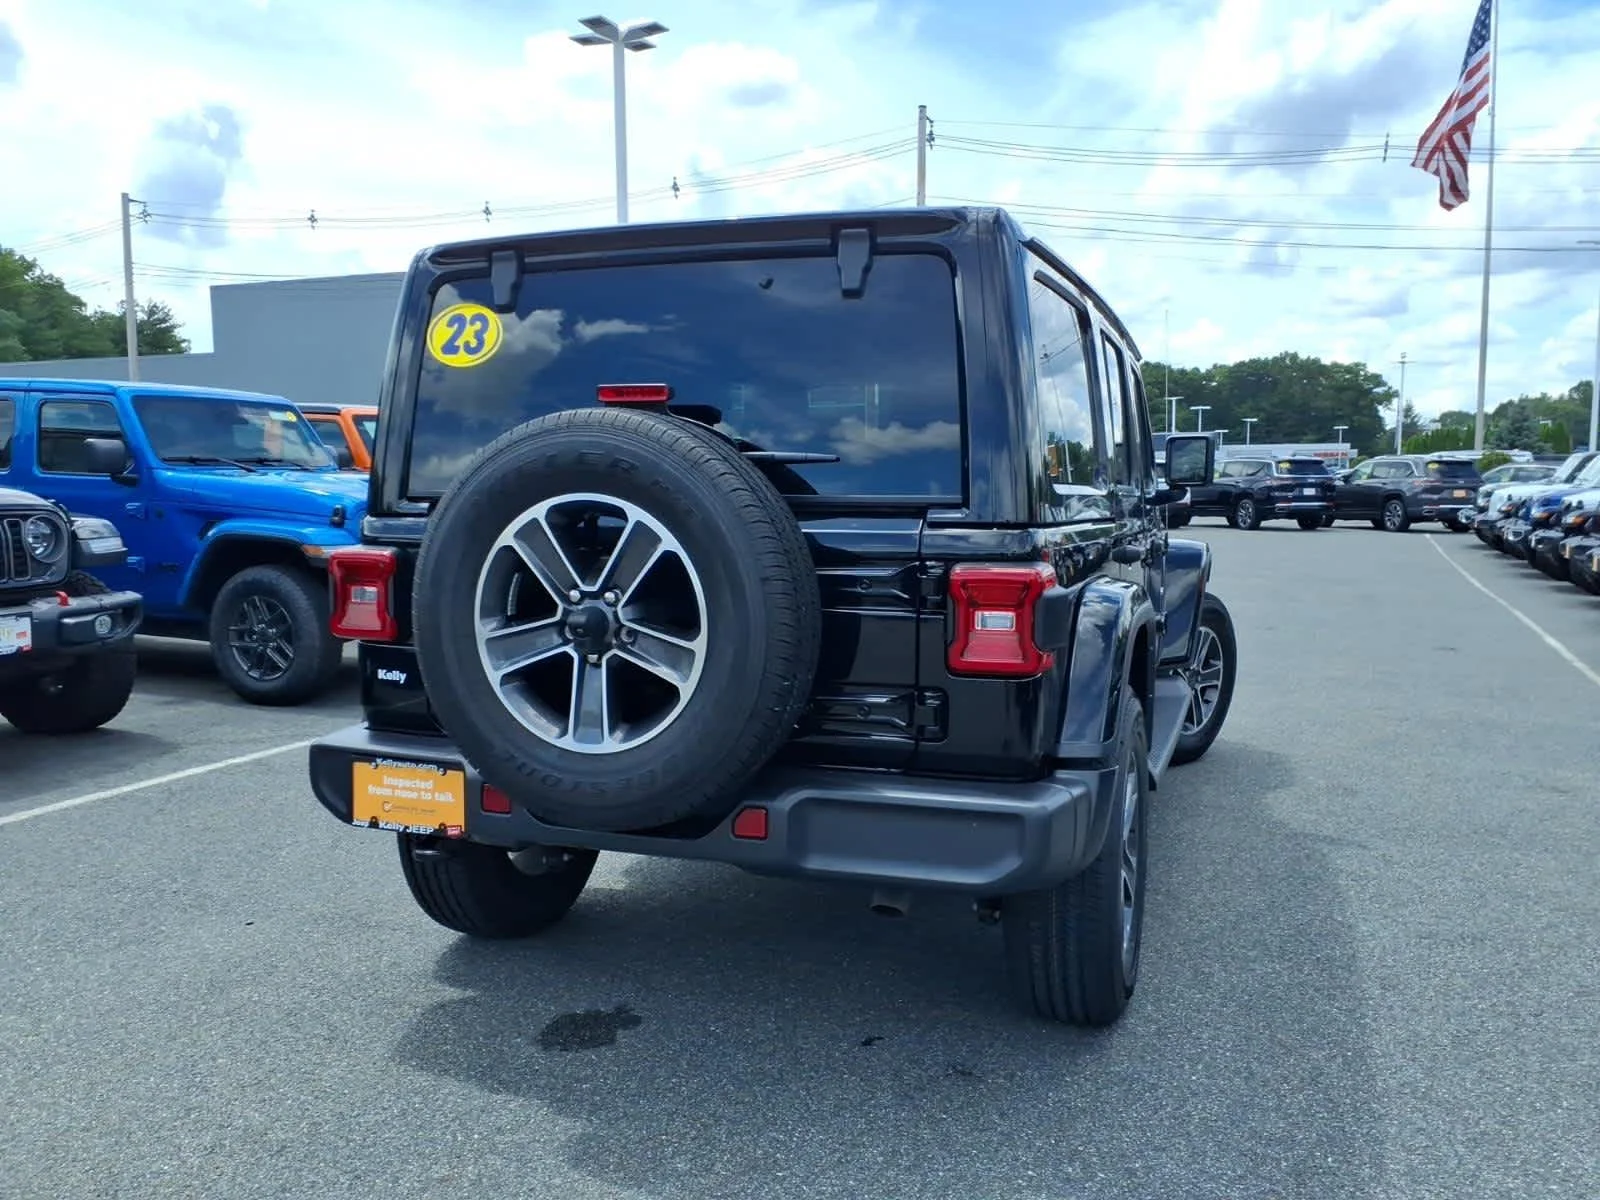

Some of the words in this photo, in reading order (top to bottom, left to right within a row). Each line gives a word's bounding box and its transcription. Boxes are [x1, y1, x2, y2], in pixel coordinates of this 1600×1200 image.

[441, 312, 489, 356] 23
[377, 668, 407, 684] Kelly
[384, 776, 433, 788] Inspected
[367, 785, 393, 795] from
[421, 791, 432, 800] to
[379, 821, 404, 832] Kelly
[406, 825, 434, 834] JEEP
